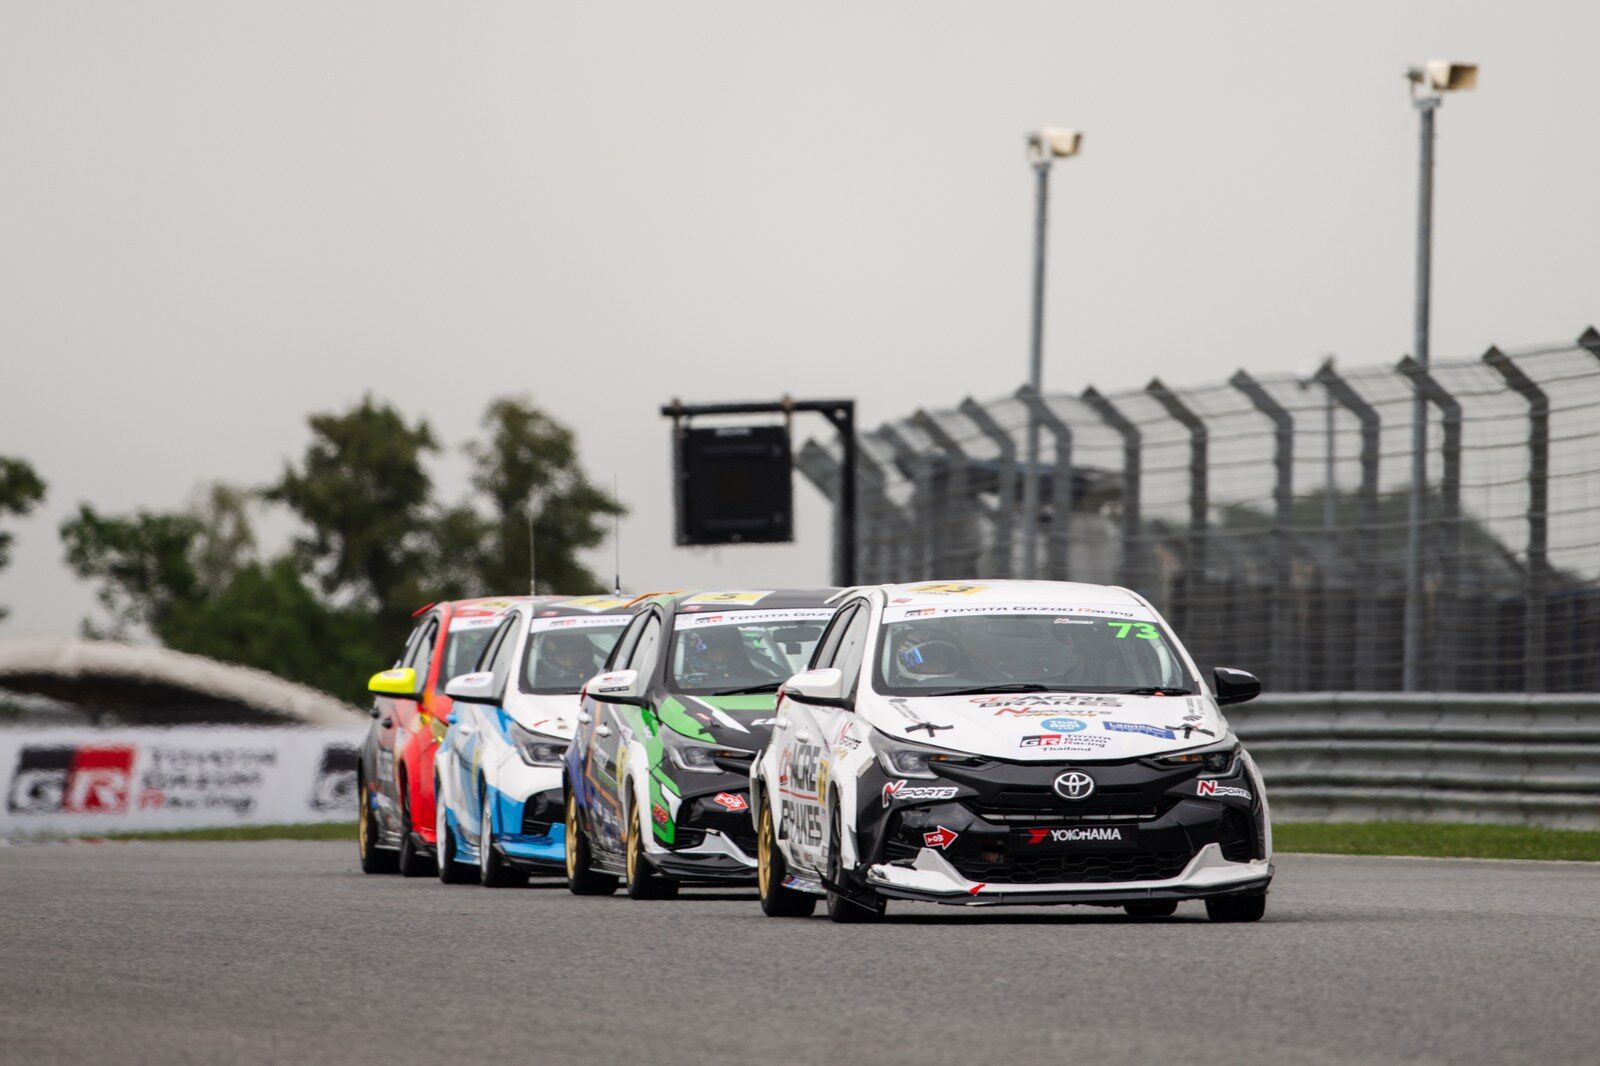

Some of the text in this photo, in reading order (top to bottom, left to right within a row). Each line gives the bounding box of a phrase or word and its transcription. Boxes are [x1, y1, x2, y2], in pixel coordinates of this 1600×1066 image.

[728, 613, 789, 621] TOYOTA
[1107, 622, 1160, 640] 73
[1020, 736, 1062, 748] GR
[7, 760, 135, 814] GR
[1050, 828, 1123, 841] YOKOHAMA
